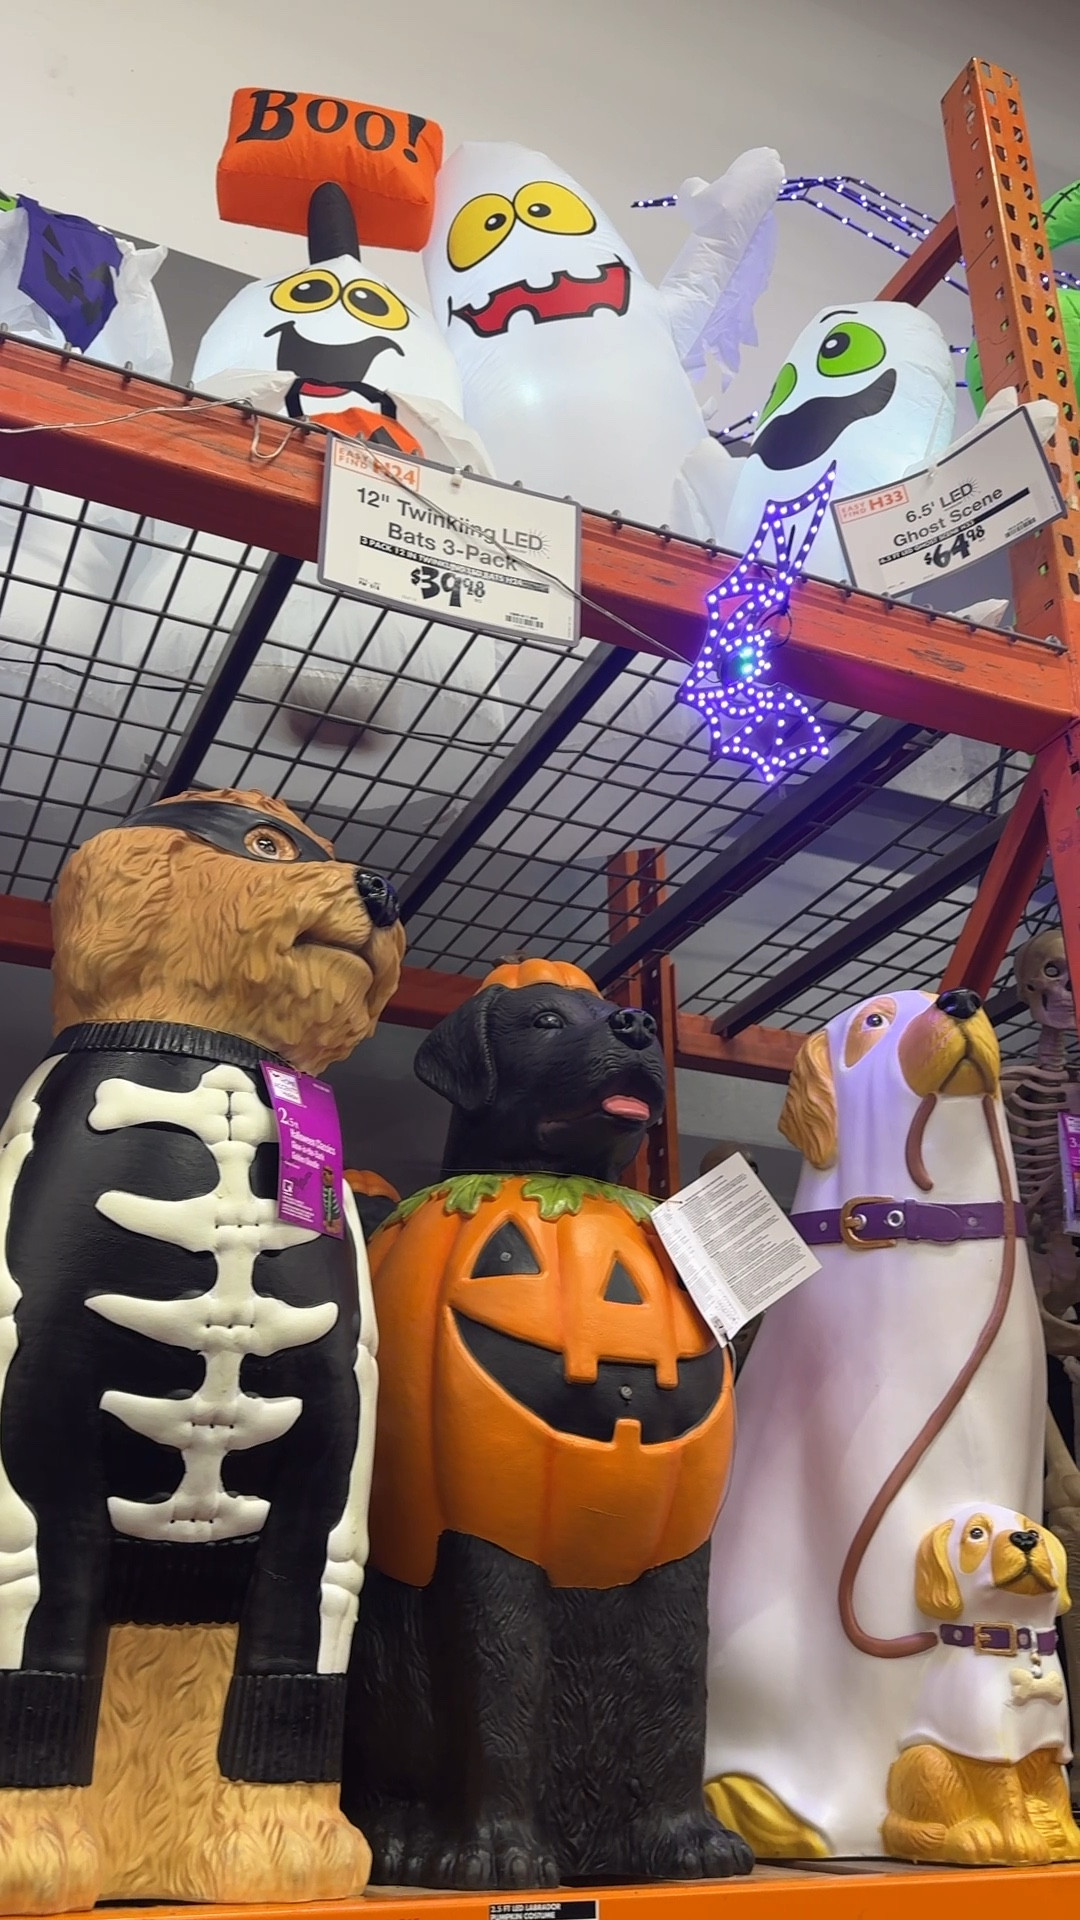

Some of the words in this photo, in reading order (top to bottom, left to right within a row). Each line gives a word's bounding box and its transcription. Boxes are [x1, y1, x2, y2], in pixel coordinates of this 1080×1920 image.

[236, 89, 427, 163] BOO!
[339, 447, 369, 461] EASY
[339, 455, 369, 469] FIND
[841, 502, 865, 513] EASY
[869, 490, 904, 511] H33
[905, 501, 936, 523] 6.5'
[940, 483, 973, 508] LED
[357, 487, 390, 508] 12"
[502, 528, 543, 551] LED
[843, 508, 867, 519] FIND
[893, 518, 947, 547] Ghost
[950, 488, 1004, 522] Scene
[369, 540, 392, 553] PACK
[388, 522, 436, 551] Bats
[443, 539, 518, 571] 3-Pack
[490, 1905, 502, 1913] 2.5
